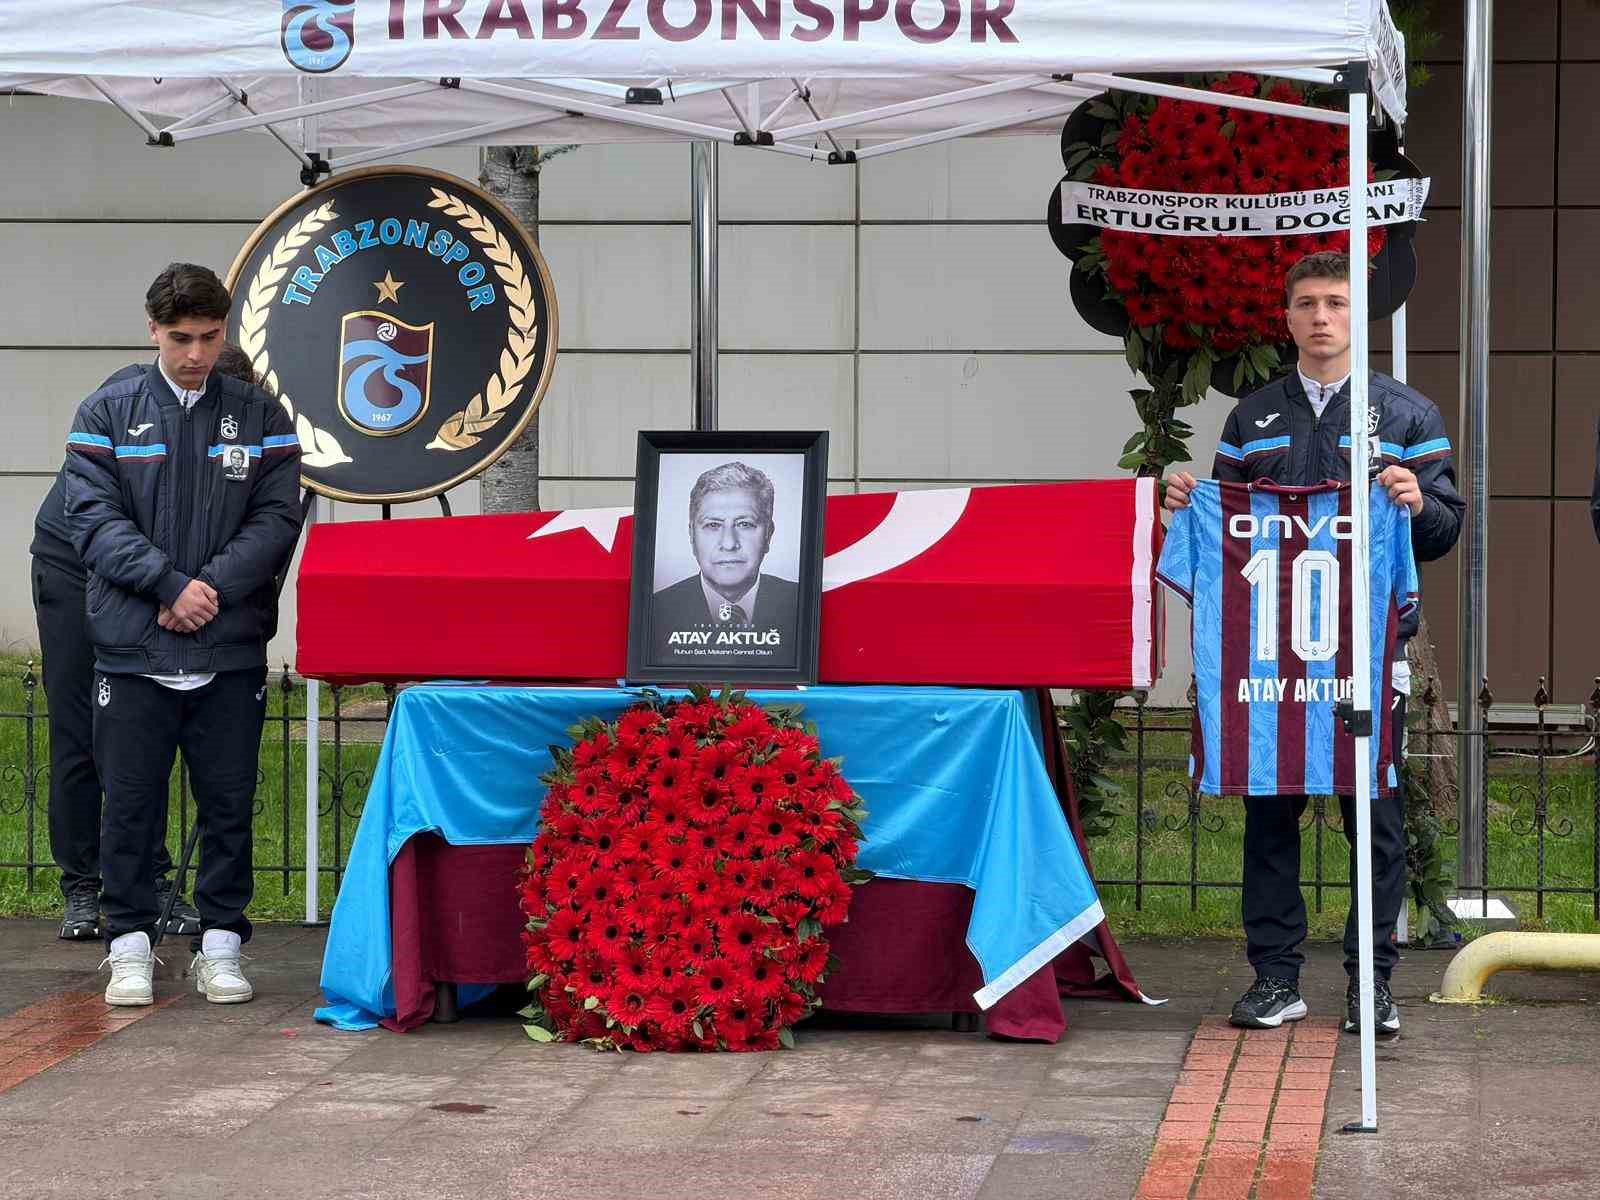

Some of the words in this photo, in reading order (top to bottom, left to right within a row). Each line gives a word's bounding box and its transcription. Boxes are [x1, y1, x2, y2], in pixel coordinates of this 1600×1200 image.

[1087, 187, 1218, 208] TRABZONSPOR
[1226, 192, 1306, 209] KULÜBÜ
[1313, 184, 1395, 205] BAŞANI
[1077, 204, 1262, 231] ERTUĞRUL
[1275, 202, 1405, 230] DOĞAN
[282, 217, 496, 312] TRABZONSPOR
[1240, 549, 1340, 662] 10
[668, 631, 712, 645] ATAY
[716, 628, 780, 645] AKTUĞ
[1238, 678, 1288, 702] ATAY
